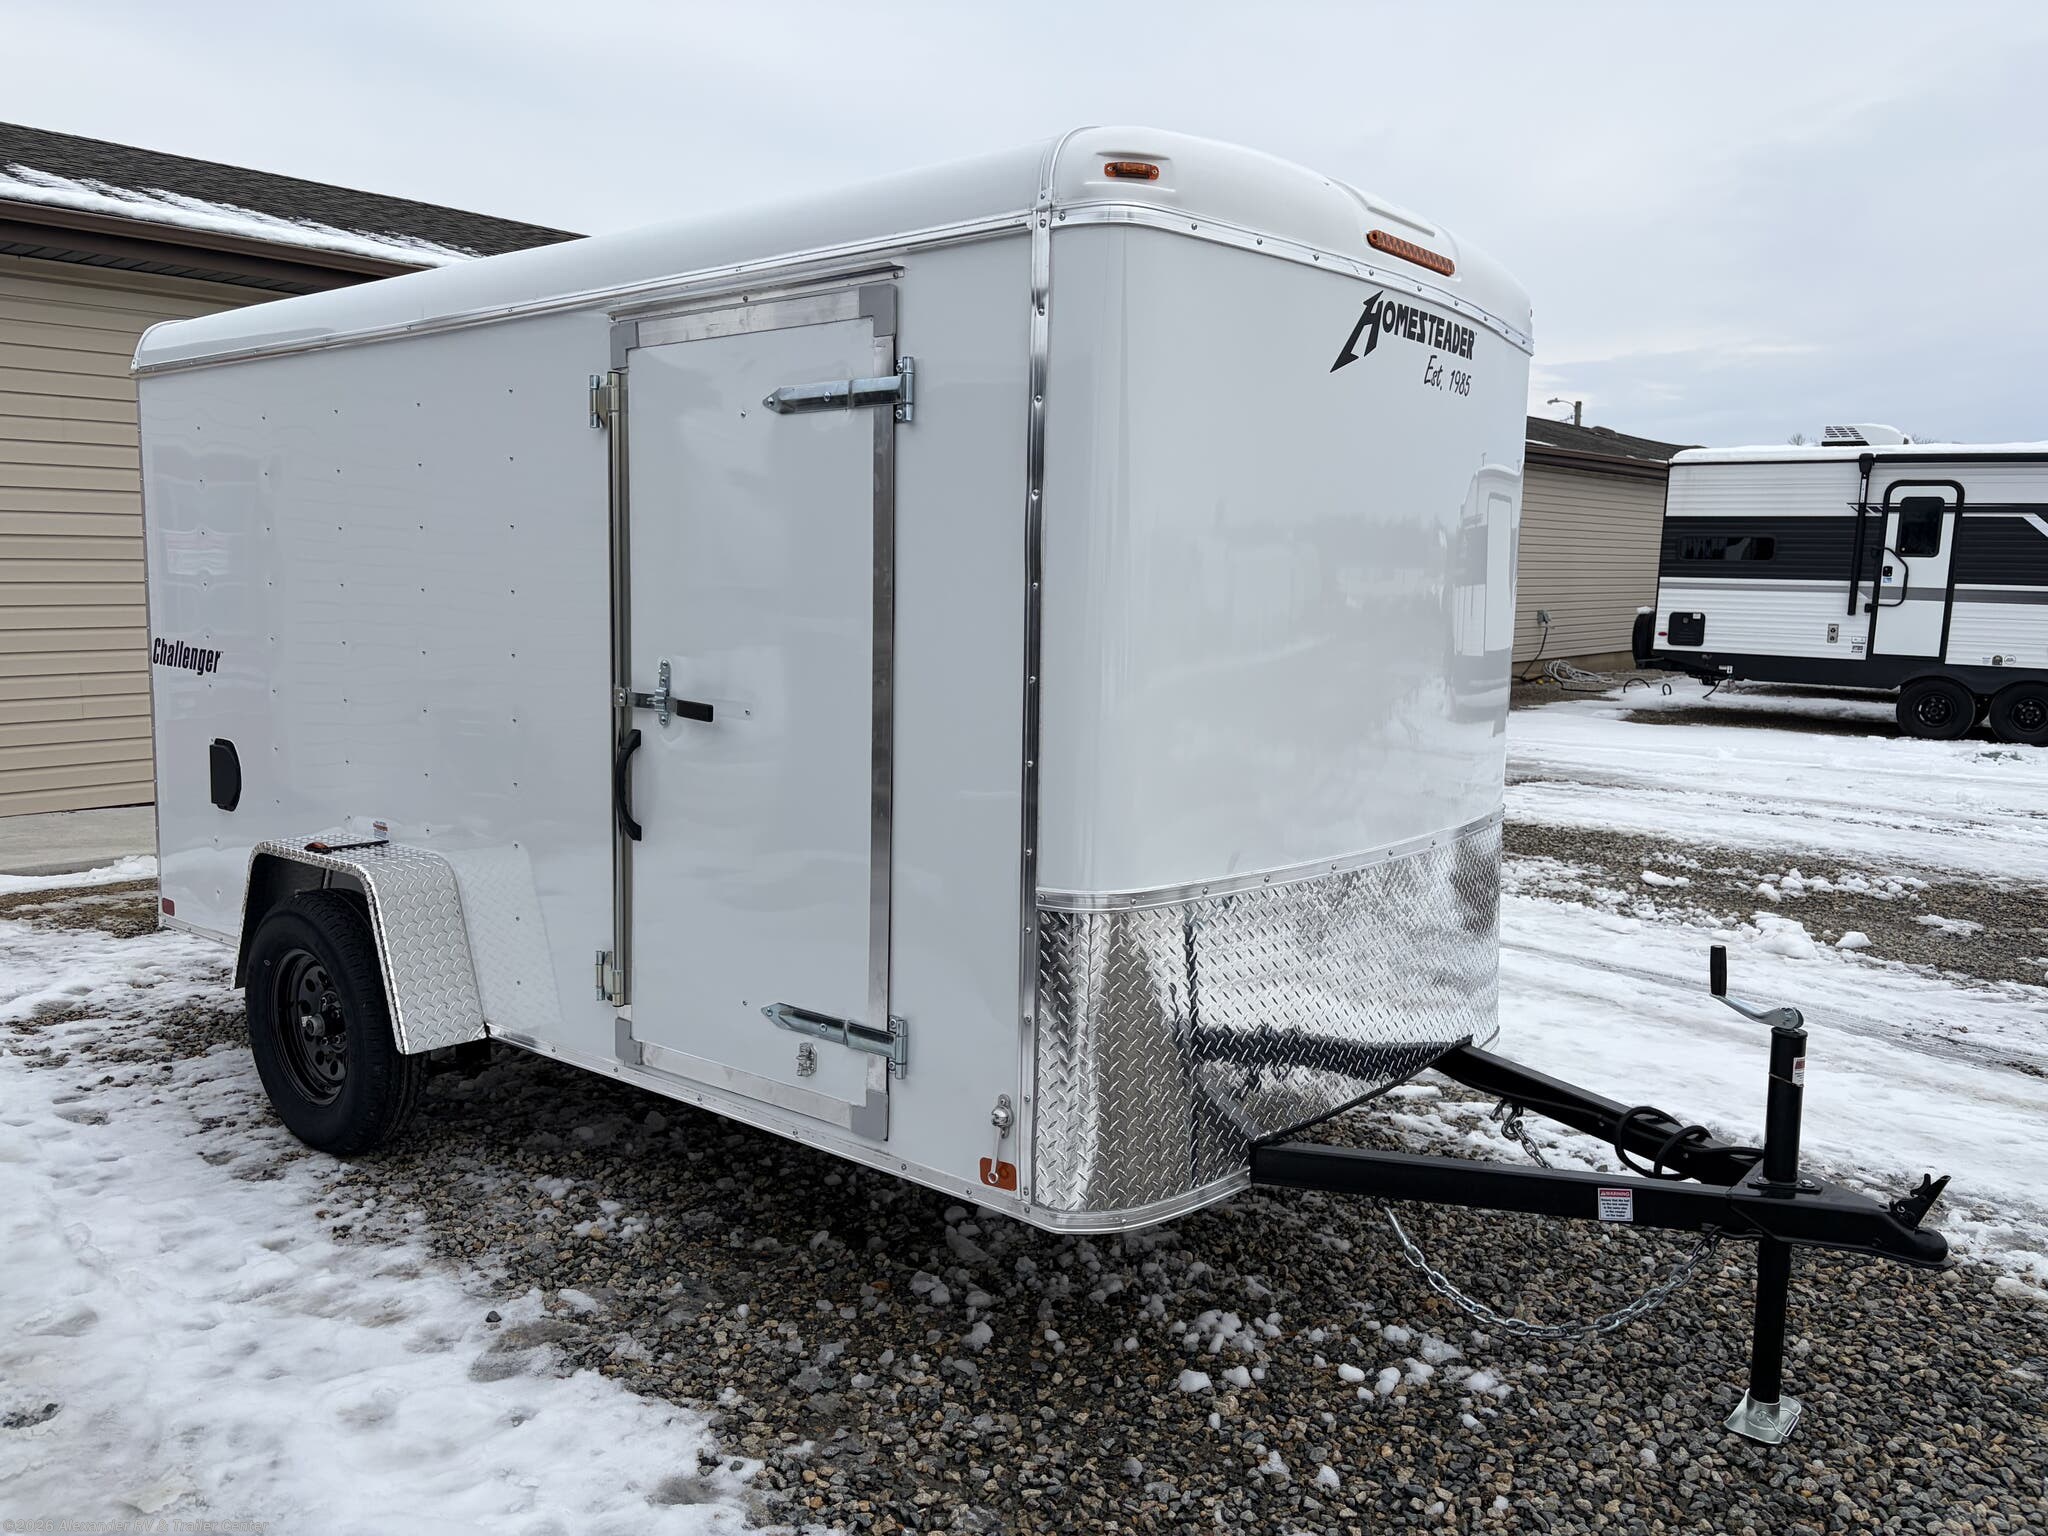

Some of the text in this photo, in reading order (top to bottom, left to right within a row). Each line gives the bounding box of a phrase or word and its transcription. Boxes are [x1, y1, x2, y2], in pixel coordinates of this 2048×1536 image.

[1329, 290, 1475, 373] HOMESTEADER
[1424, 354, 1472, 397] Est. 1985
[152, 637, 221, 676] Challenger
